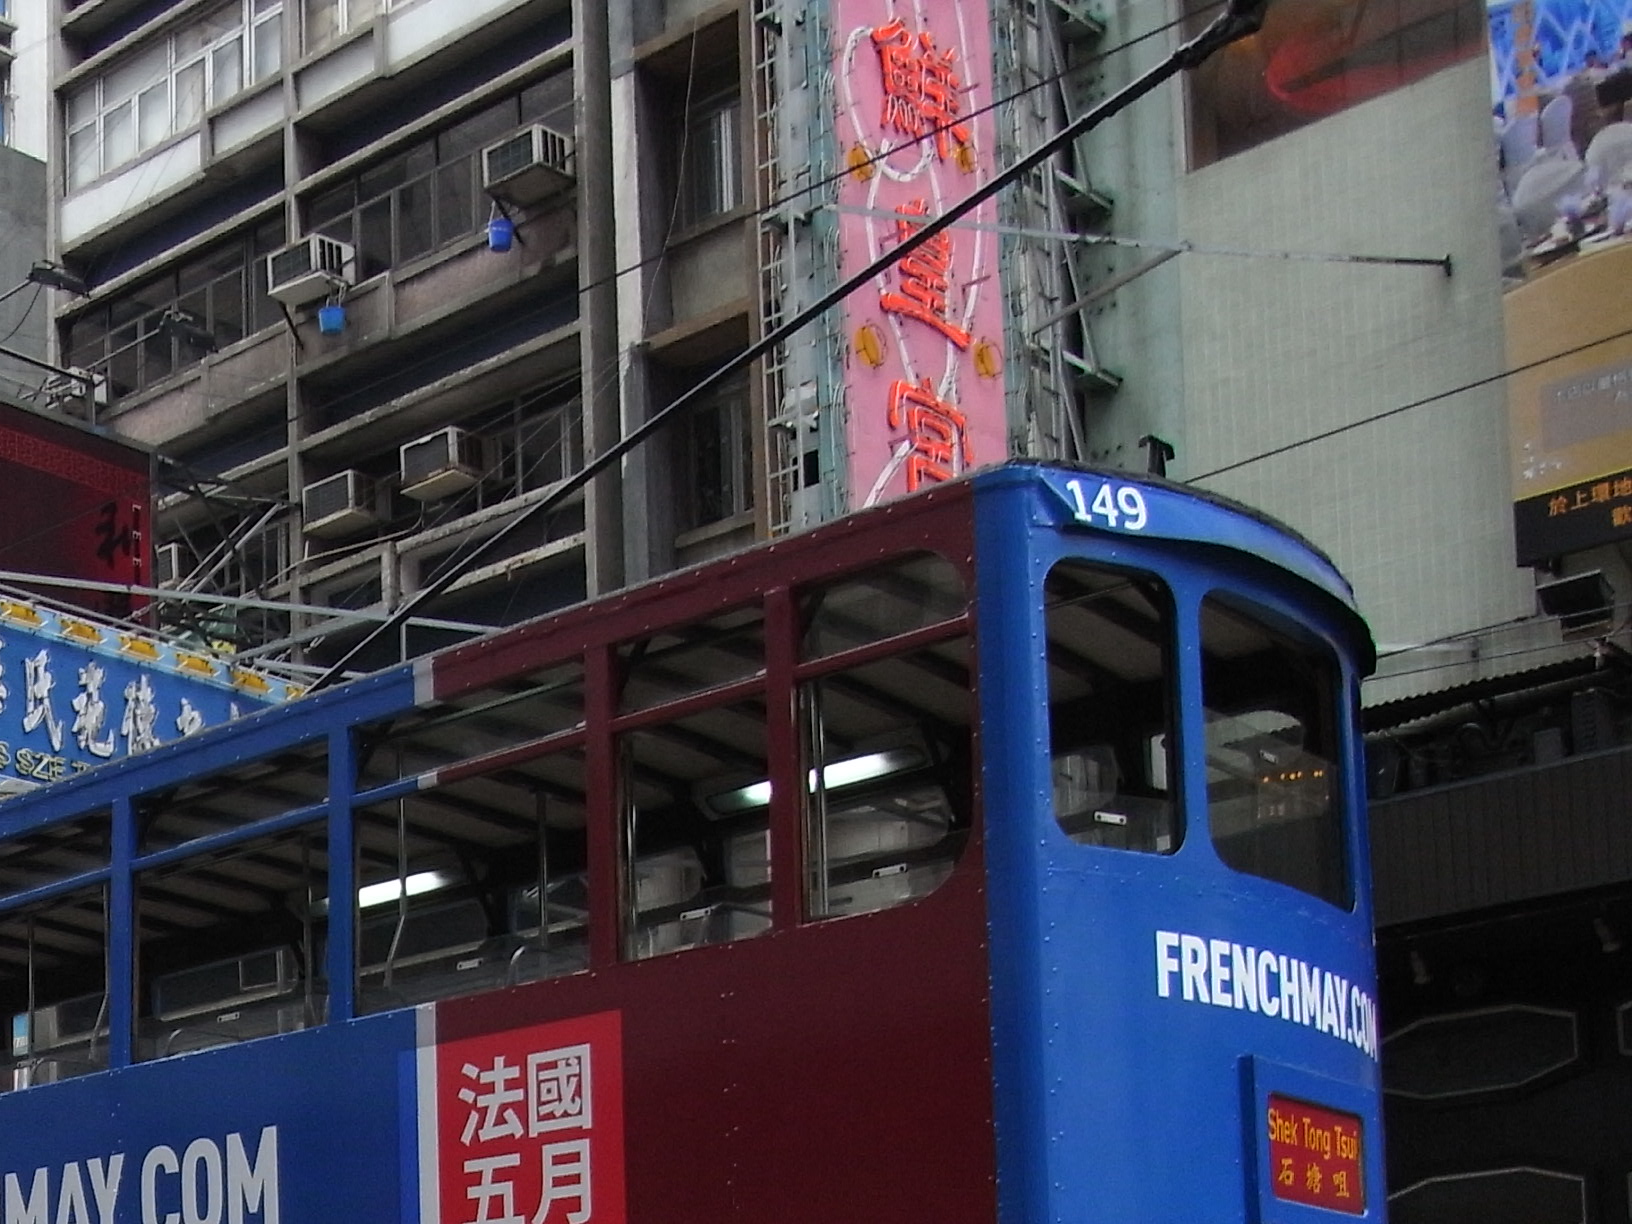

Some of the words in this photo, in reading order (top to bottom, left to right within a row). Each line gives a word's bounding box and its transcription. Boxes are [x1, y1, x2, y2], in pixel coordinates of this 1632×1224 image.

[1066, 479, 1148, 531] 149
[1155, 929, 1378, 1064] FRENCHMAY.COM
[1267, 1107, 1299, 1147] Shek
[1302, 1116, 1331, 1161] Tong
[1334, 1124, 1360, 1161] Tsui
[1277, 1156, 1351, 1199] 石塘咀
